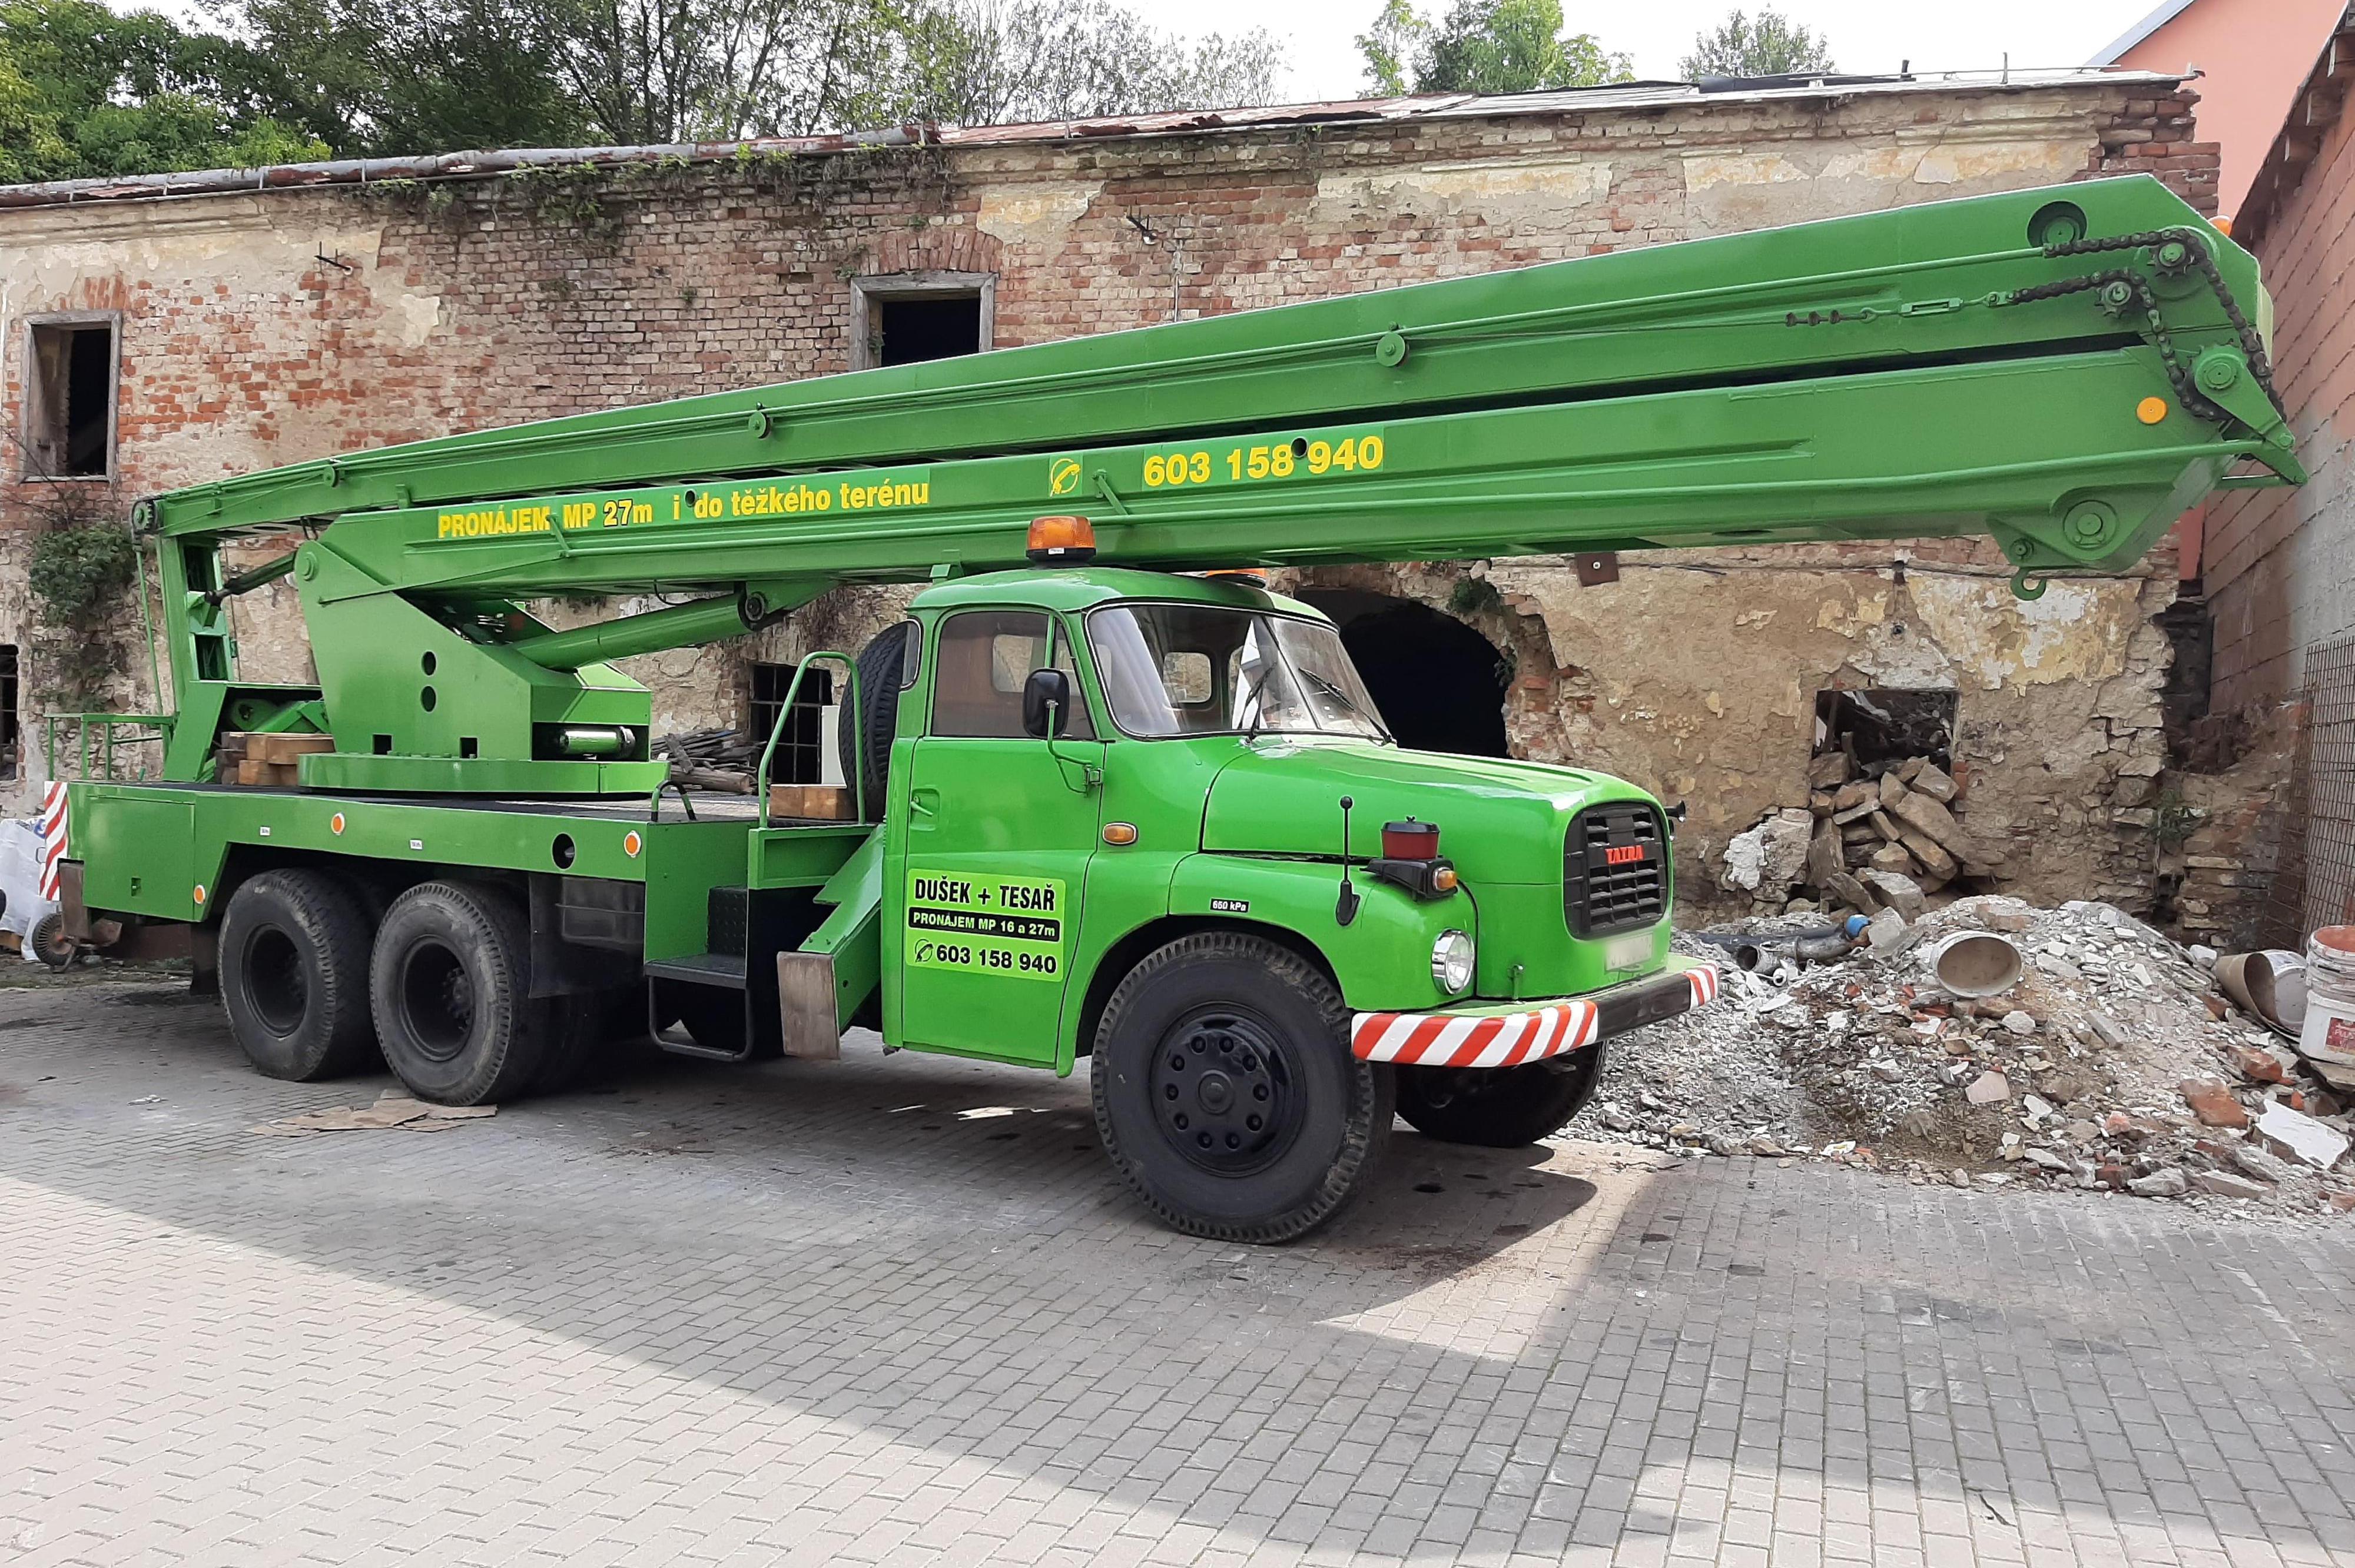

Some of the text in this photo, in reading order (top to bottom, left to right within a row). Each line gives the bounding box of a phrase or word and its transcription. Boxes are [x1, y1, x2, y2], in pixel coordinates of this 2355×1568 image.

[1144, 436, 1383, 486] 603 158 940
[439, 479, 928, 538] PRONÁJEM MP 27m i do těžkého terénu
[1605, 845, 1644, 863] TATRA
[916, 875, 970, 903] DUŠEK
[1000, 884, 1055, 911] TESAŘ
[1230, 901, 1246, 911] kPa
[913, 912, 1055, 936] PRONÁJEM MP 16 a 27m
[937, 945, 1057, 974] 603 158 940
